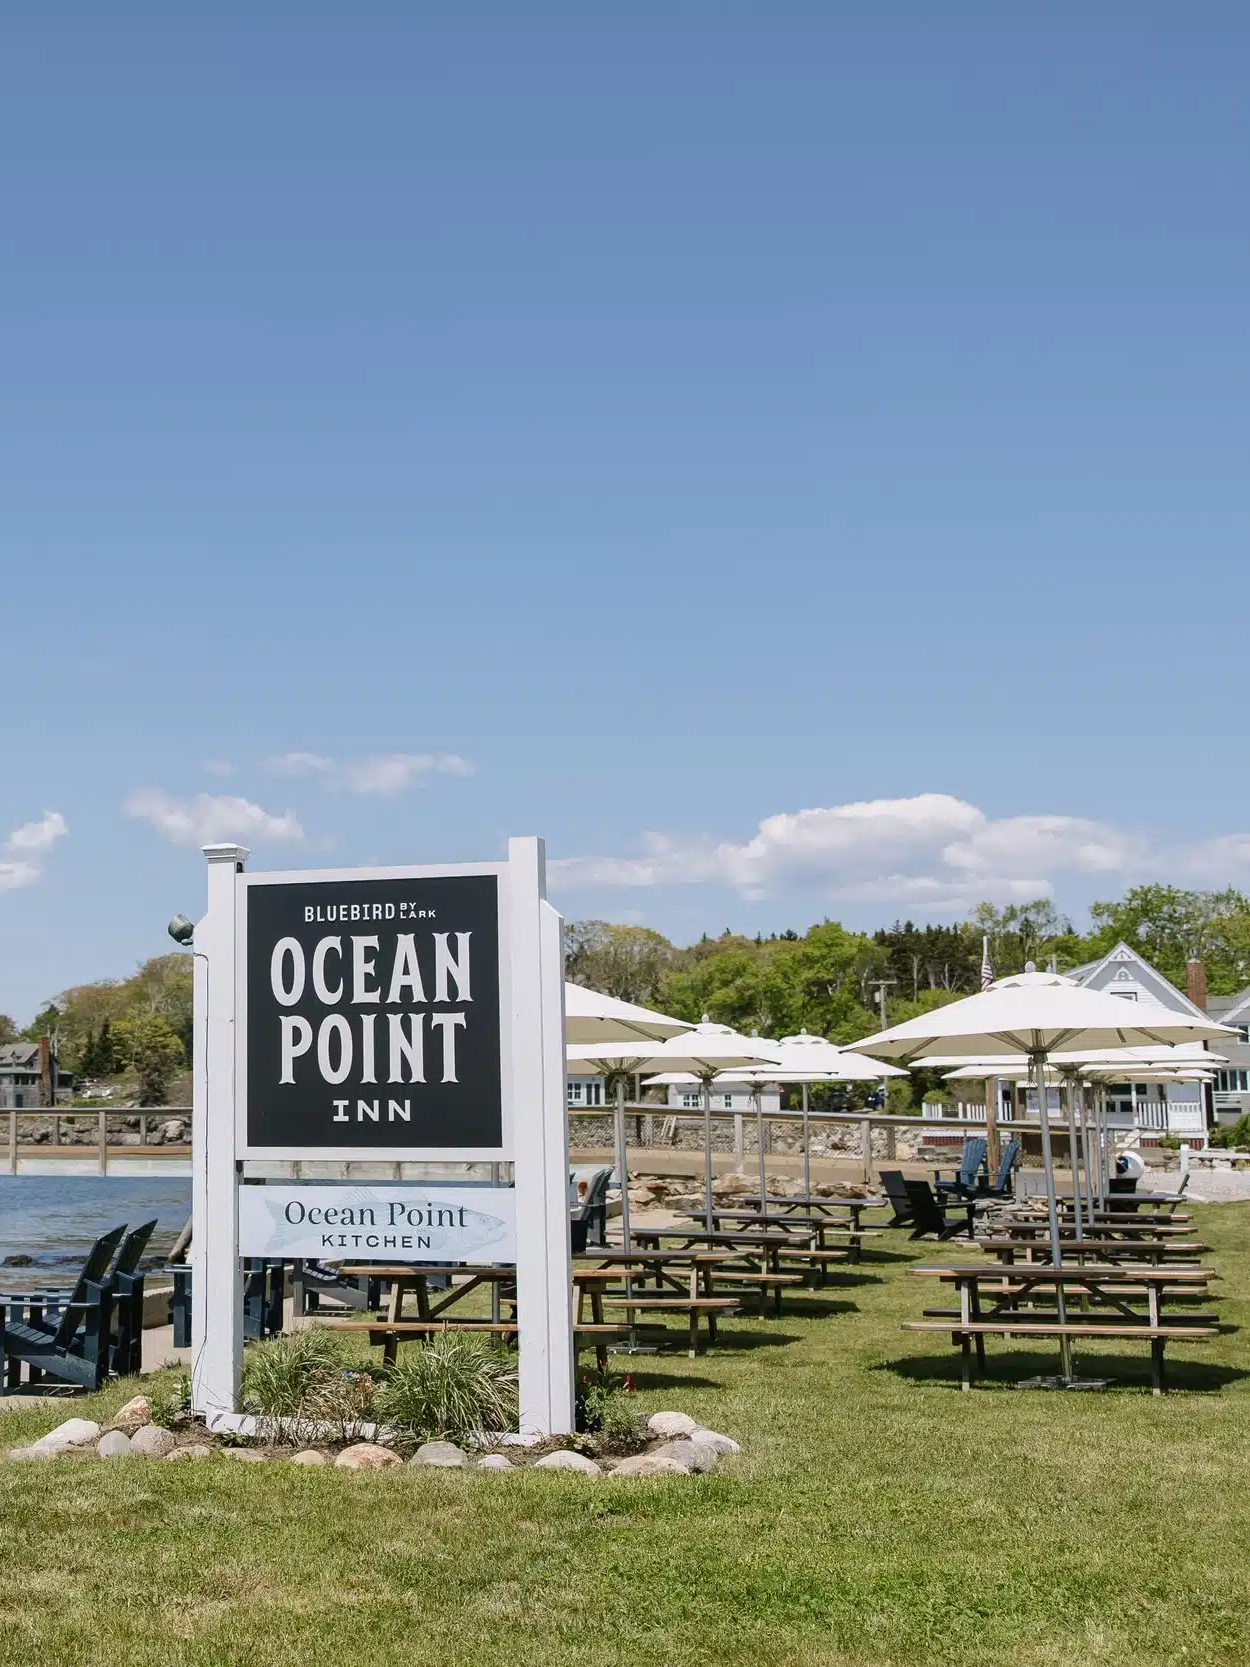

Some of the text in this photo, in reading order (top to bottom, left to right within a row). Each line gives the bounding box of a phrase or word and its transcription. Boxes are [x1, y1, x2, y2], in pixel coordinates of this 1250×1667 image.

[304, 903, 395, 923] BLUEBIRD
[399, 902, 417, 911] BY
[399, 910, 437, 919] LARK
[270, 932, 474, 1007] OCEAN
[278, 1011, 468, 1085] POINT
[332, 1099, 412, 1122] INN
[284, 1200, 468, 1228] Ocean Point
[321, 1234, 432, 1249] KITCHEN
